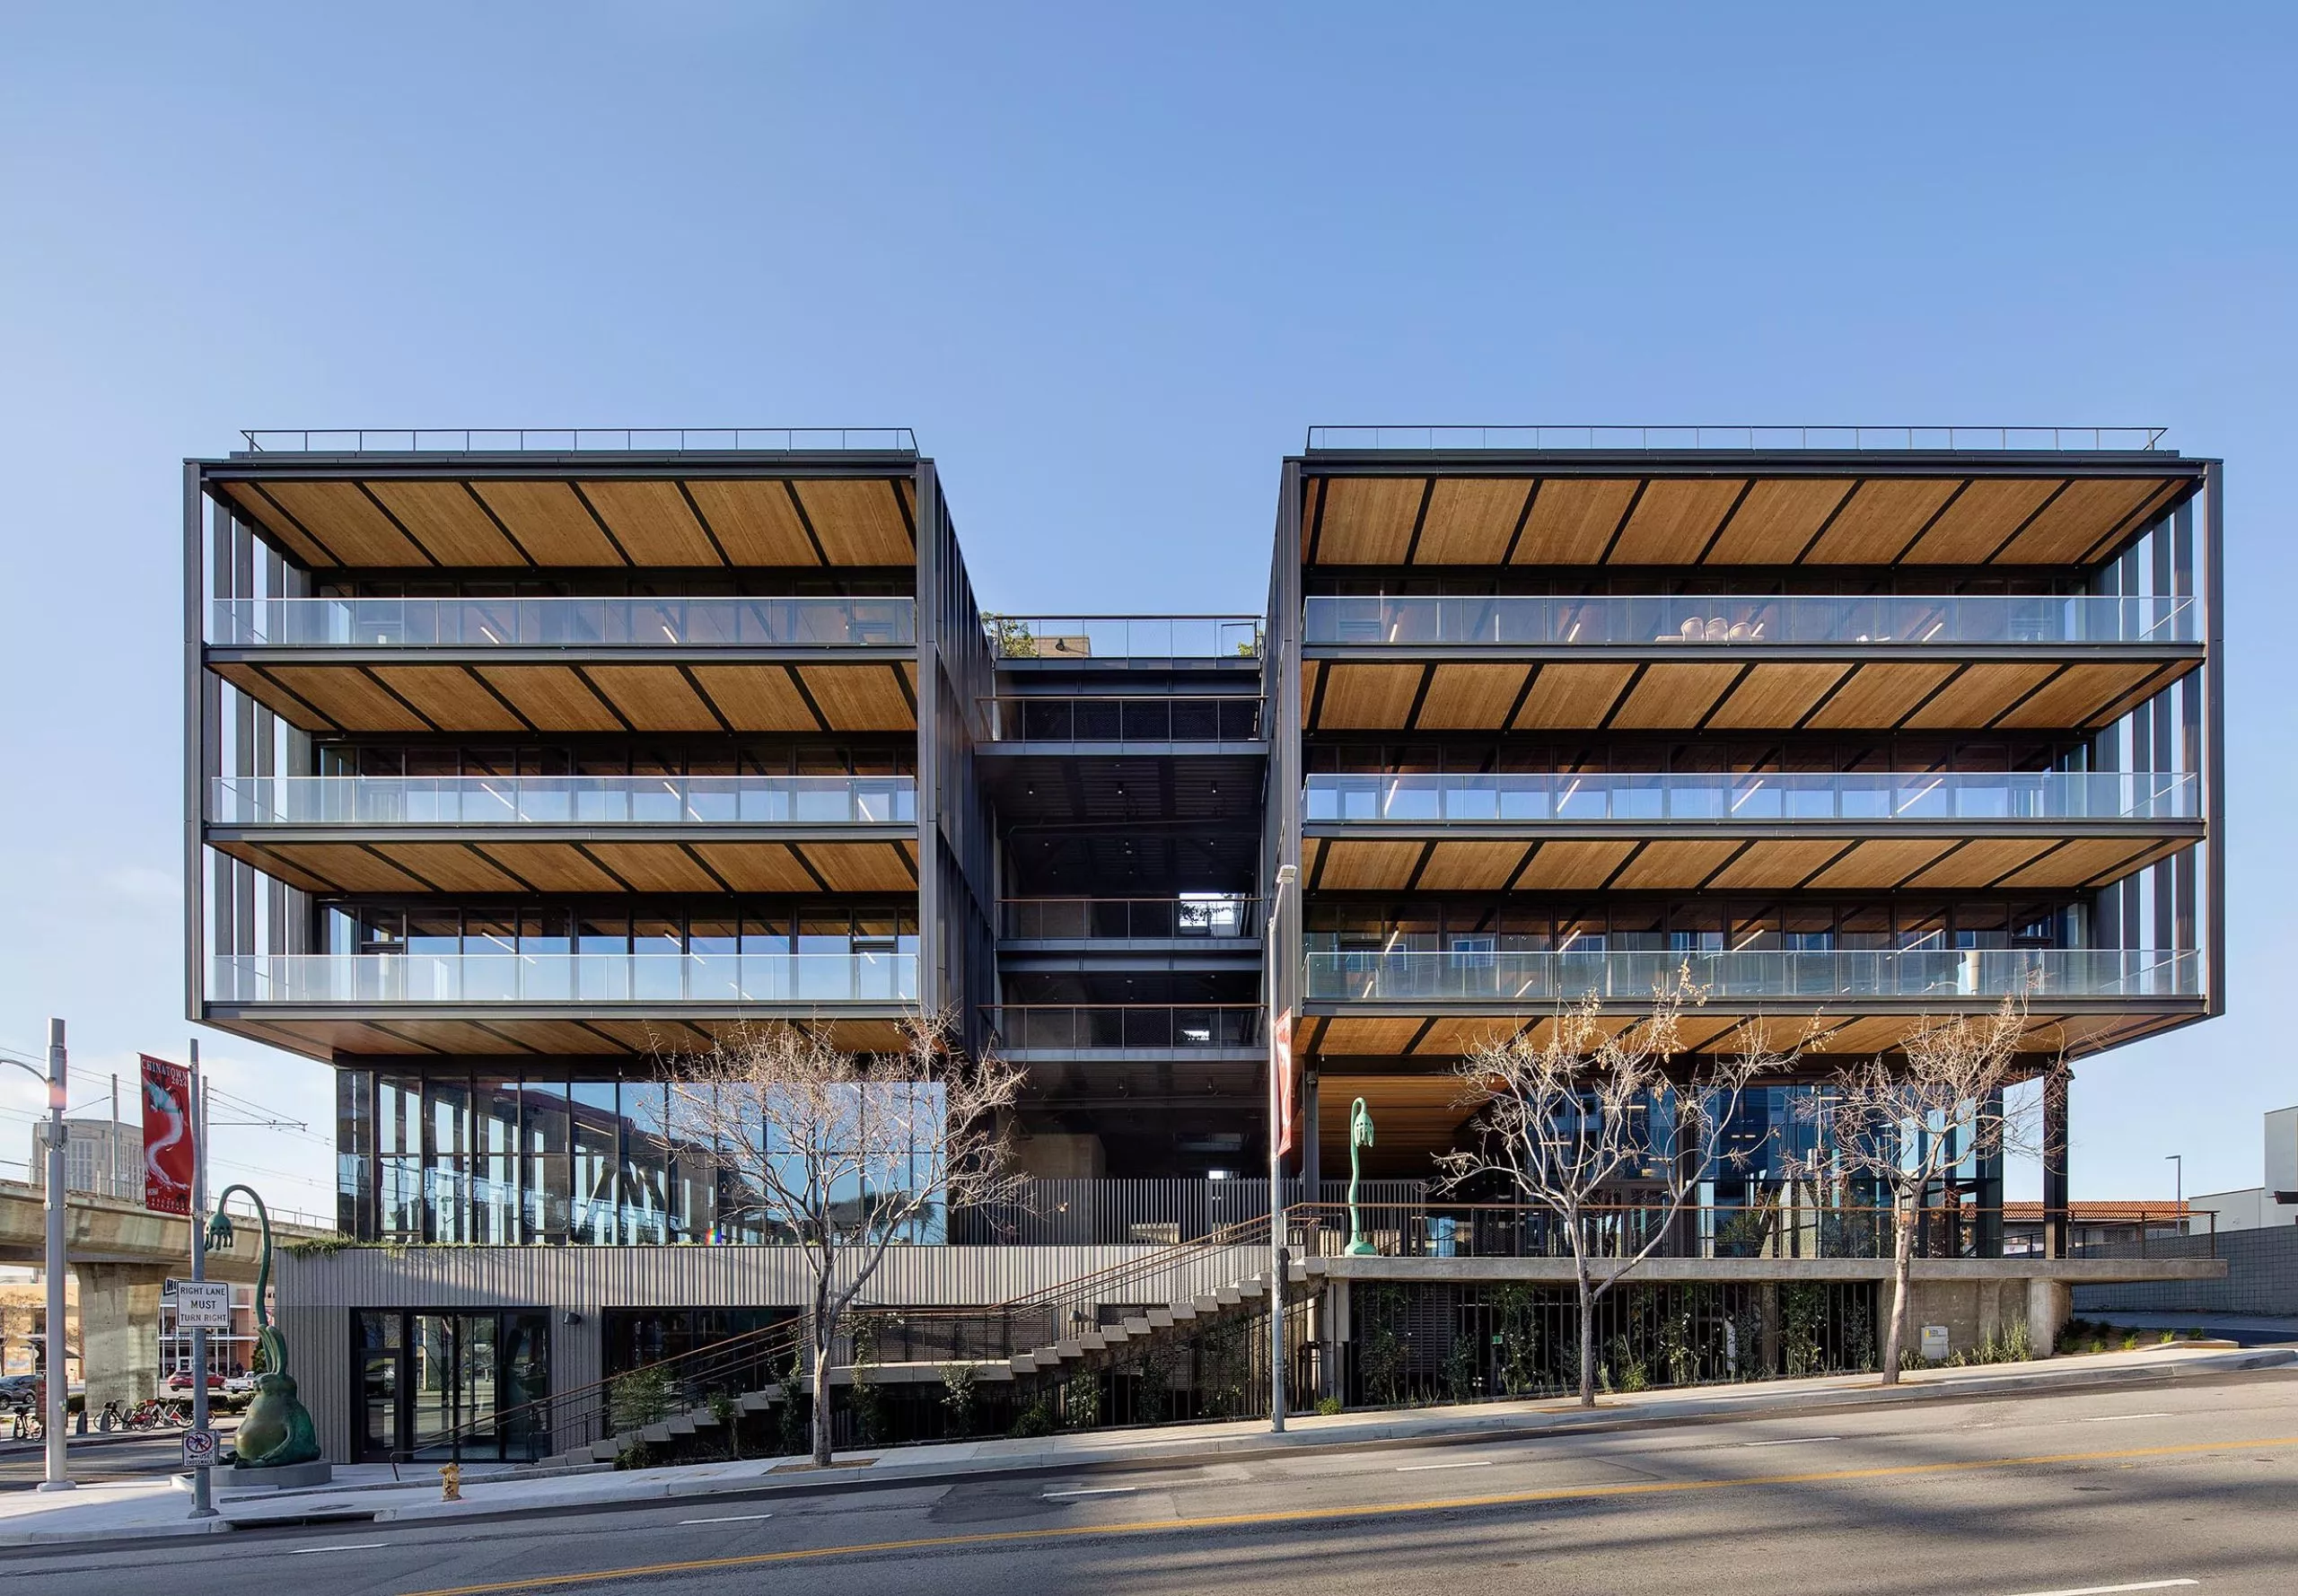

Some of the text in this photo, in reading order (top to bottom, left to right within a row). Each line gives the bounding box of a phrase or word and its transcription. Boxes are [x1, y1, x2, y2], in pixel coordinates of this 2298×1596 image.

[142, 1059, 187, 1081] CHINATOWN
[171, 1077, 187, 1087] 2024
[191, 1301, 216, 1309] MUST
